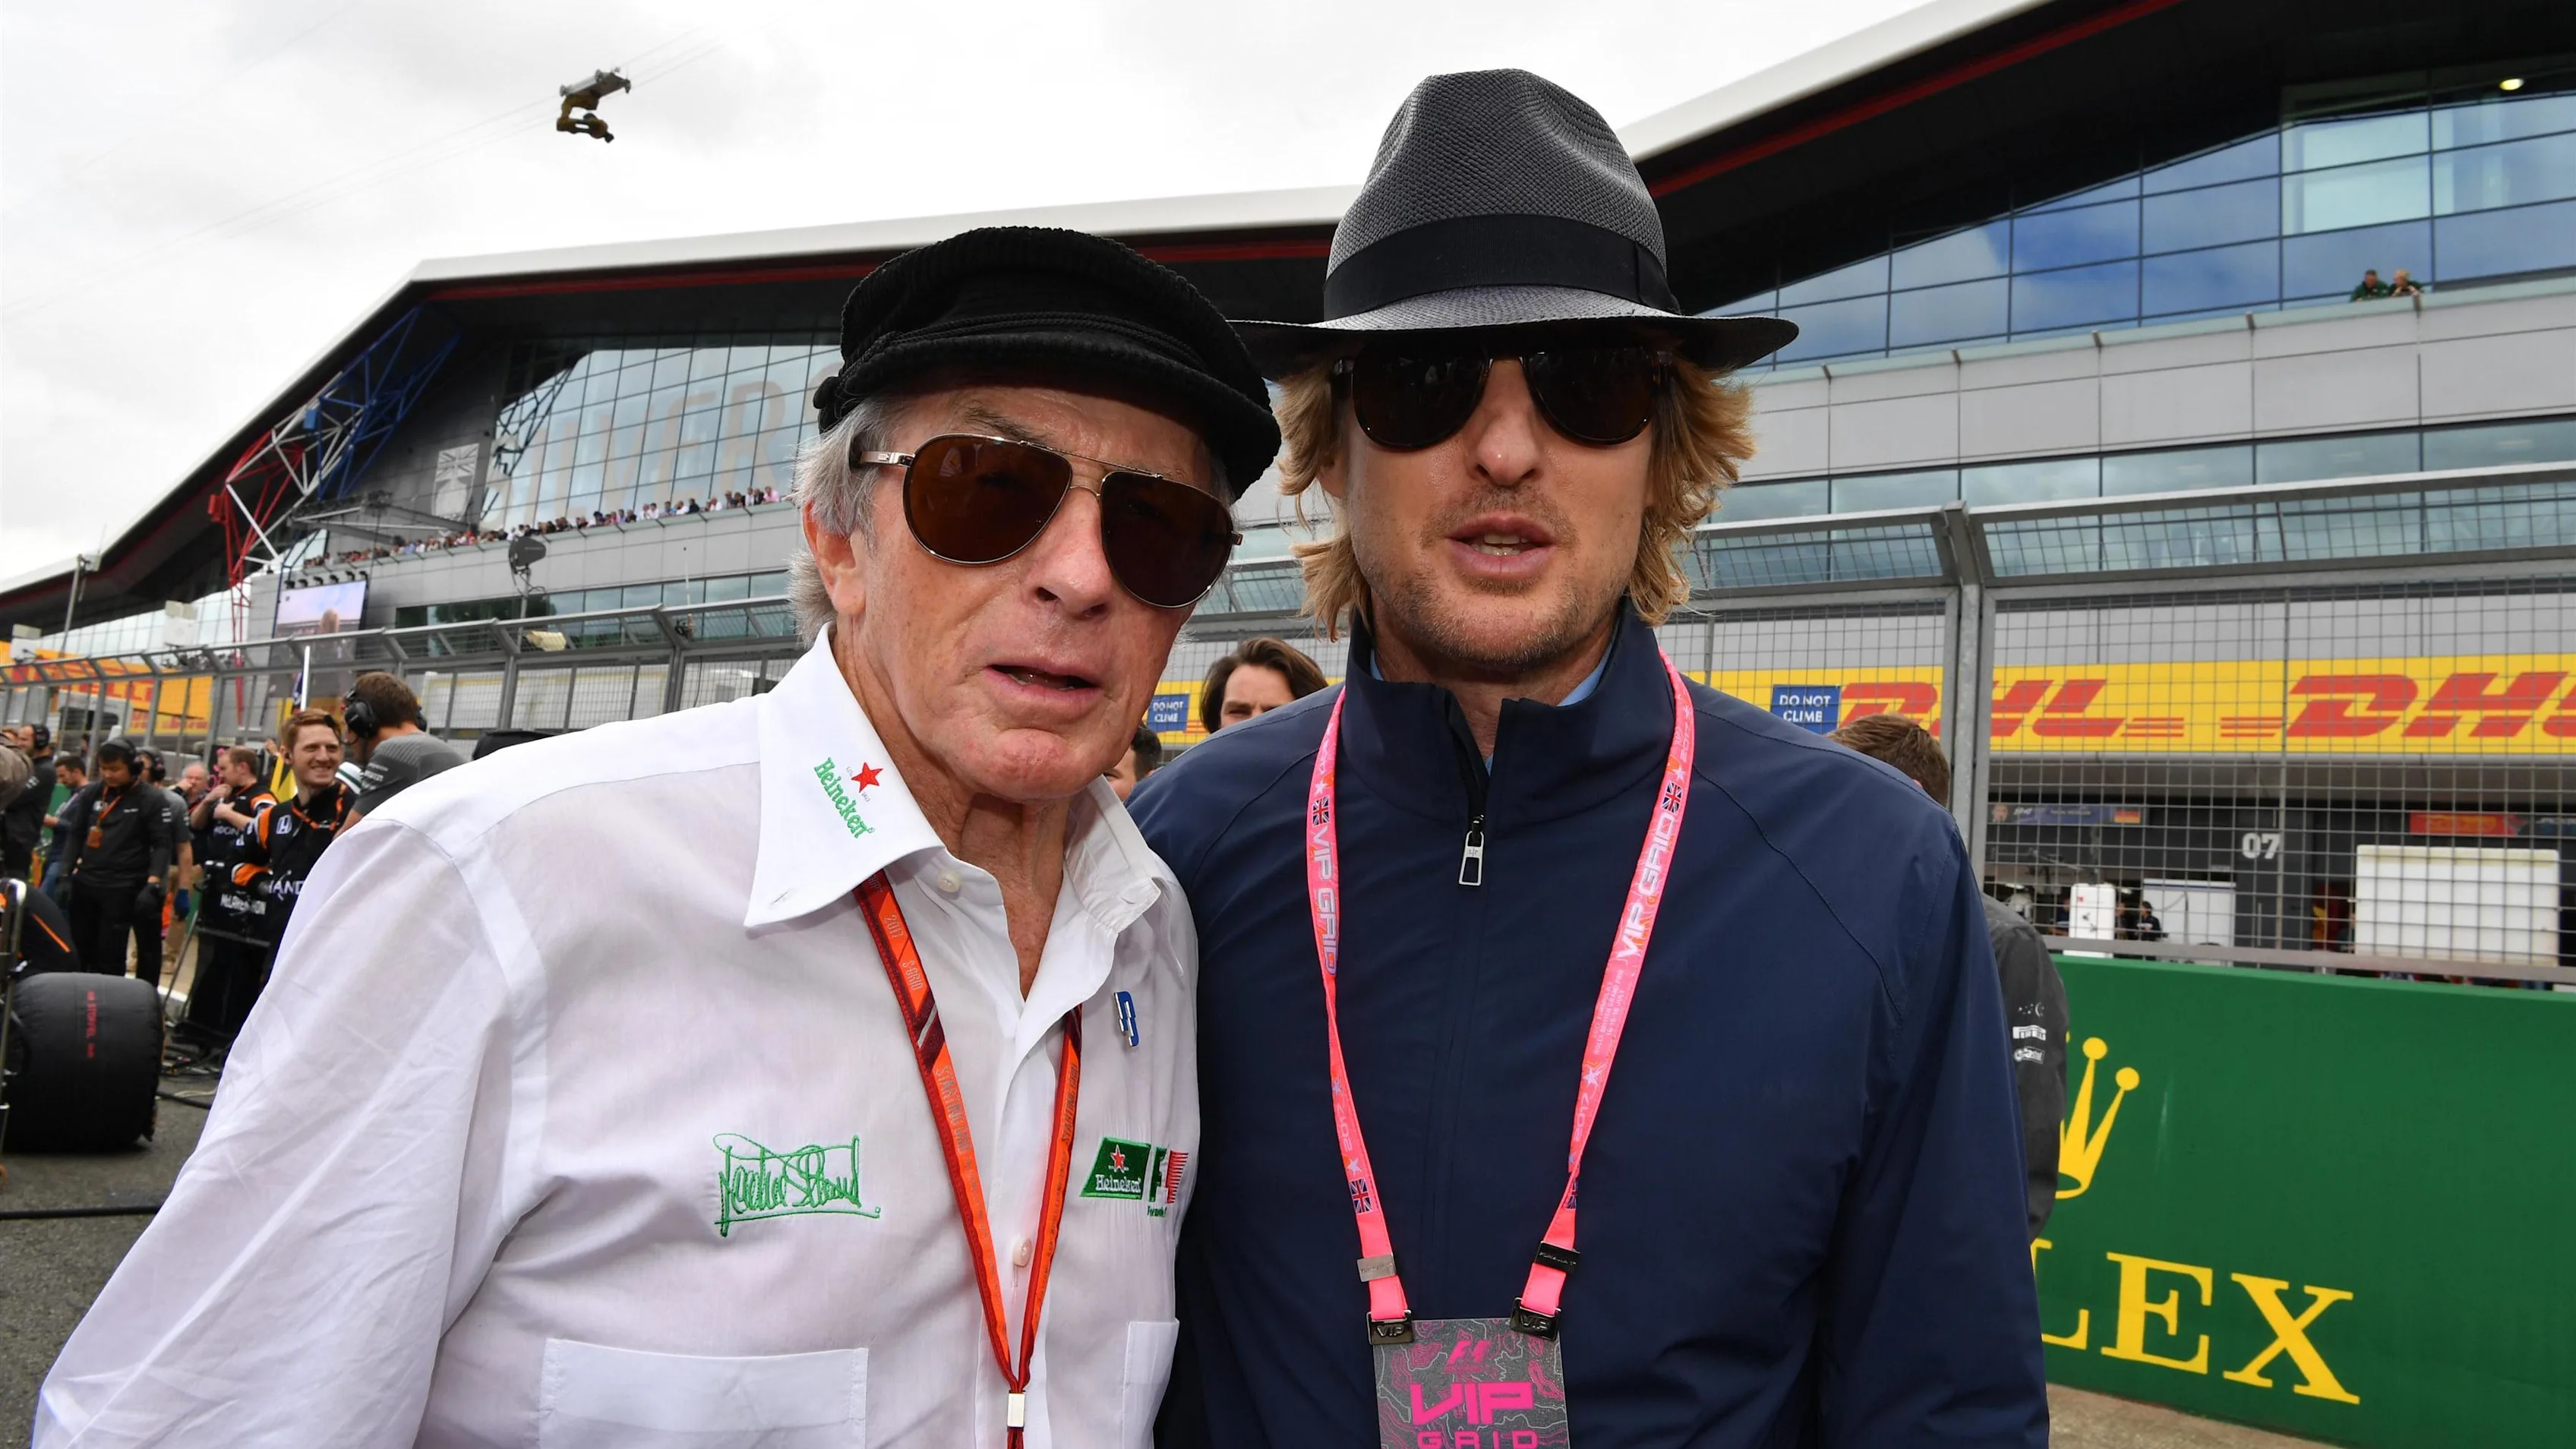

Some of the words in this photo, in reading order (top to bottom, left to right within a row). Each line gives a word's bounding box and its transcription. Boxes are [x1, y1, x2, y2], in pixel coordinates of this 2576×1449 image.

[478, 365, 841, 530] SILVER
[1152, 702, 1166, 712] DO
[1166, 701, 1184, 710] NOT
[1779, 694, 1801, 706] DO
[1803, 695, 1832, 707] NOT
[1783, 710, 1823, 723] CLIMB
[814, 757, 869, 838] Heineken
[1312, 826, 1334, 881] VIP
[1637, 813, 1676, 897] GRID
[2242, 832, 2280, 859] 07
[883, 914, 904, 939] 2017
[1317, 887, 1339, 975] GRID
[1617, 901, 1646, 959] VIP
[1608, 983, 1619, 1007] GRAND
[1336, 1103, 1353, 1152] 2017
[1376, 1323, 1405, 1337] VIP
[1520, 1314, 1548, 1331] VIP
[1410, 1381, 1534, 1426] VIP
[1417, 1430, 1539, 1449] GRID
